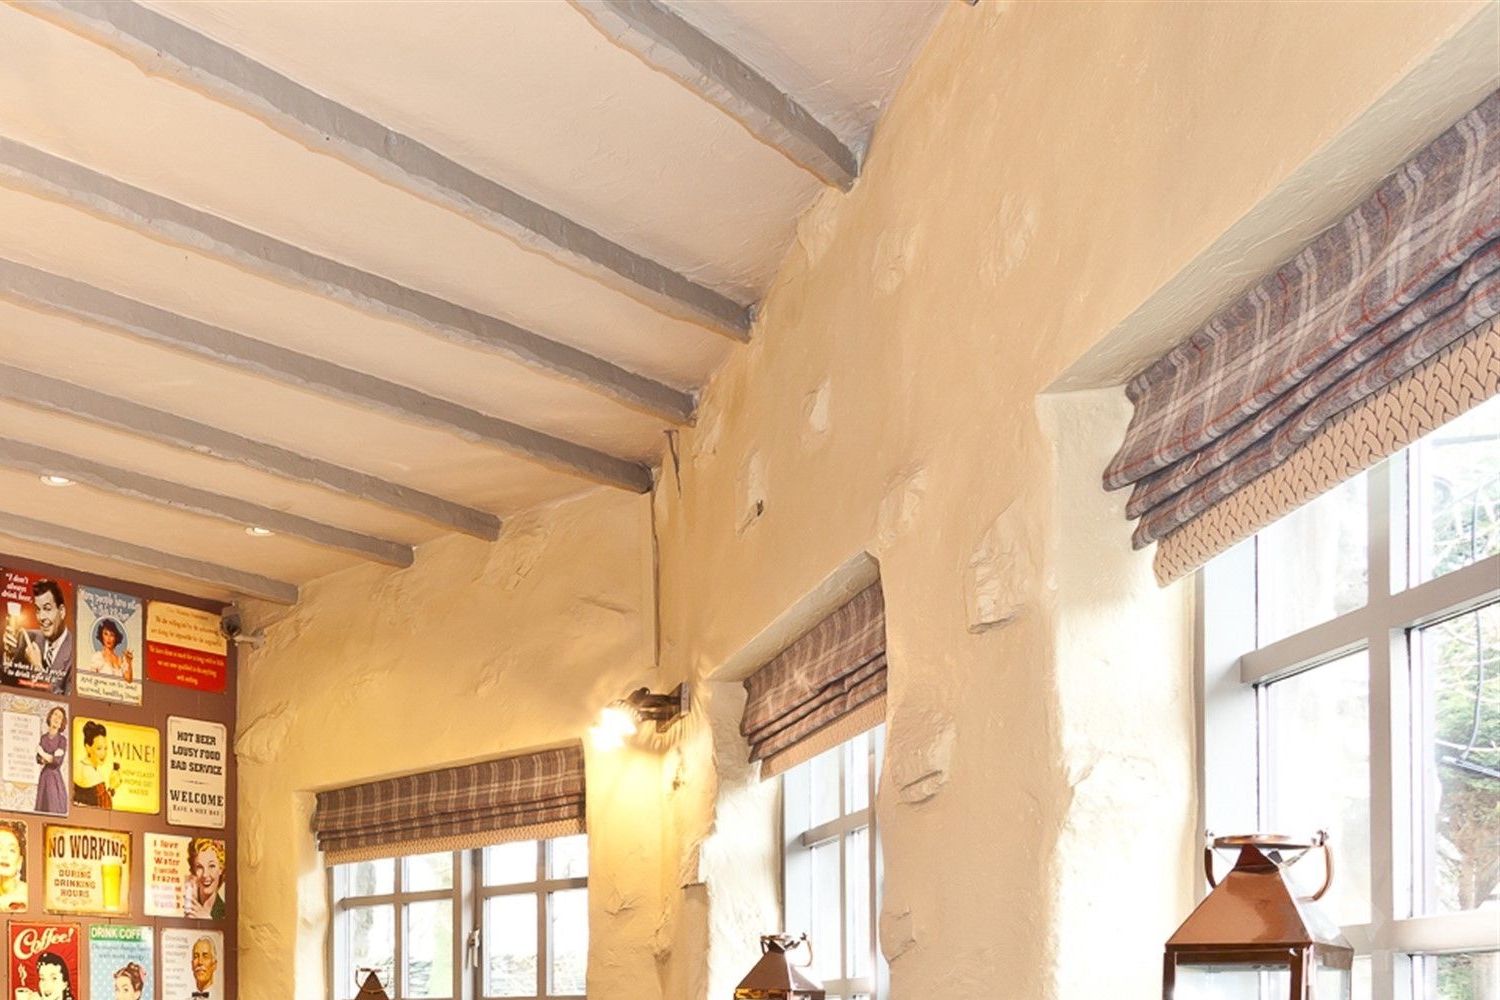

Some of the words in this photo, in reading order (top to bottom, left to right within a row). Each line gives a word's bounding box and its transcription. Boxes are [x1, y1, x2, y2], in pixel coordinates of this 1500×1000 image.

[177, 731, 193, 742] HOT
[195, 734, 216, 745] BEER
[112, 741, 155, 763] WINE!
[172, 745, 198, 758] LOUSY
[200, 749, 220, 760] FOOD
[171, 760, 187, 770] BAD
[189, 762, 222, 775] SERVICE
[170, 790, 223, 806] WELCOME
[48, 837, 65, 858] NO
[69, 835, 128, 864] WORKING
[59, 869, 92, 879] DURING
[54, 879, 96, 890] DRINKING
[60, 888, 90, 898] HOURS
[91, 927, 117, 938] DRINK
[13, 928, 74, 960] Coffee!
